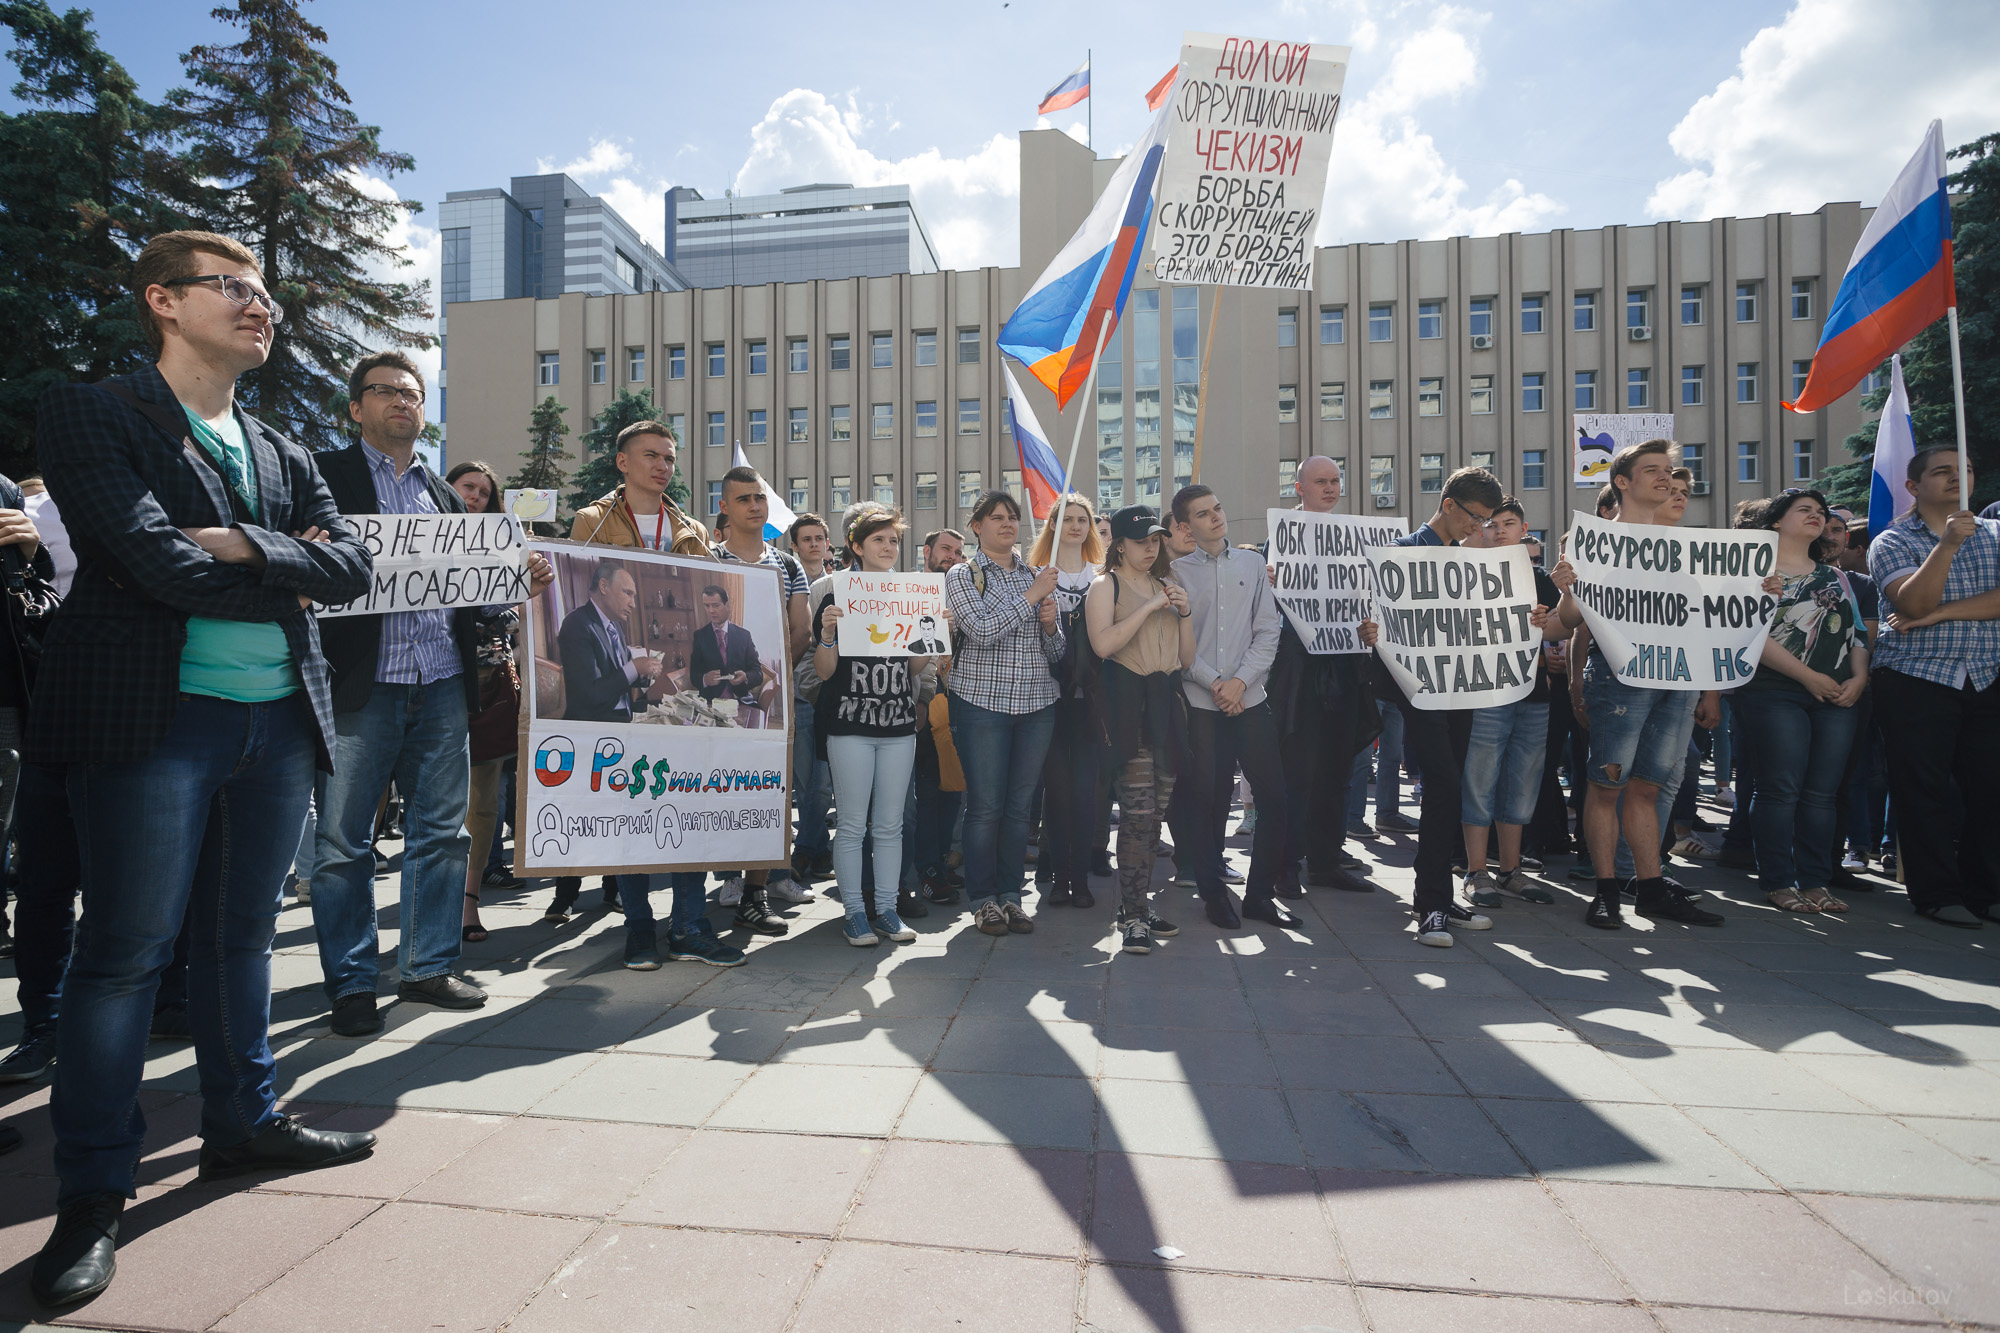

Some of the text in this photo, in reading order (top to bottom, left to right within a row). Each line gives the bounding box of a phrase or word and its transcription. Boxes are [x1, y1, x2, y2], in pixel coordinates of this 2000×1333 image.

[1215, 37, 1311, 86] ДОЛОЙ
[1196, 128, 1303, 176] ЧЕКИЗМ
[1196, 175, 1285, 209] БОРЬБА
[1170, 233, 1305, 263] ЭТО БОРЬБА
[1237, 260, 1312, 289] ПУТИНА
[1585, 415, 1673, 431] РОССИЯ ГОТОВА
[391, 518, 430, 557] НЕ
[1275, 518, 1307, 556] ФБК
[1274, 561, 1318, 590] ГОЛОС
[1690, 541, 1773, 577] МНОГО
[405, 564, 531, 606] САБОТАЖ
[848, 597, 941, 619] КОРРУПЦИЕЙ
[1379, 603, 1532, 647] ИМПИЧМЕНТ
[850, 660, 911, 696] ROCK
[534, 735, 575, 787] О
